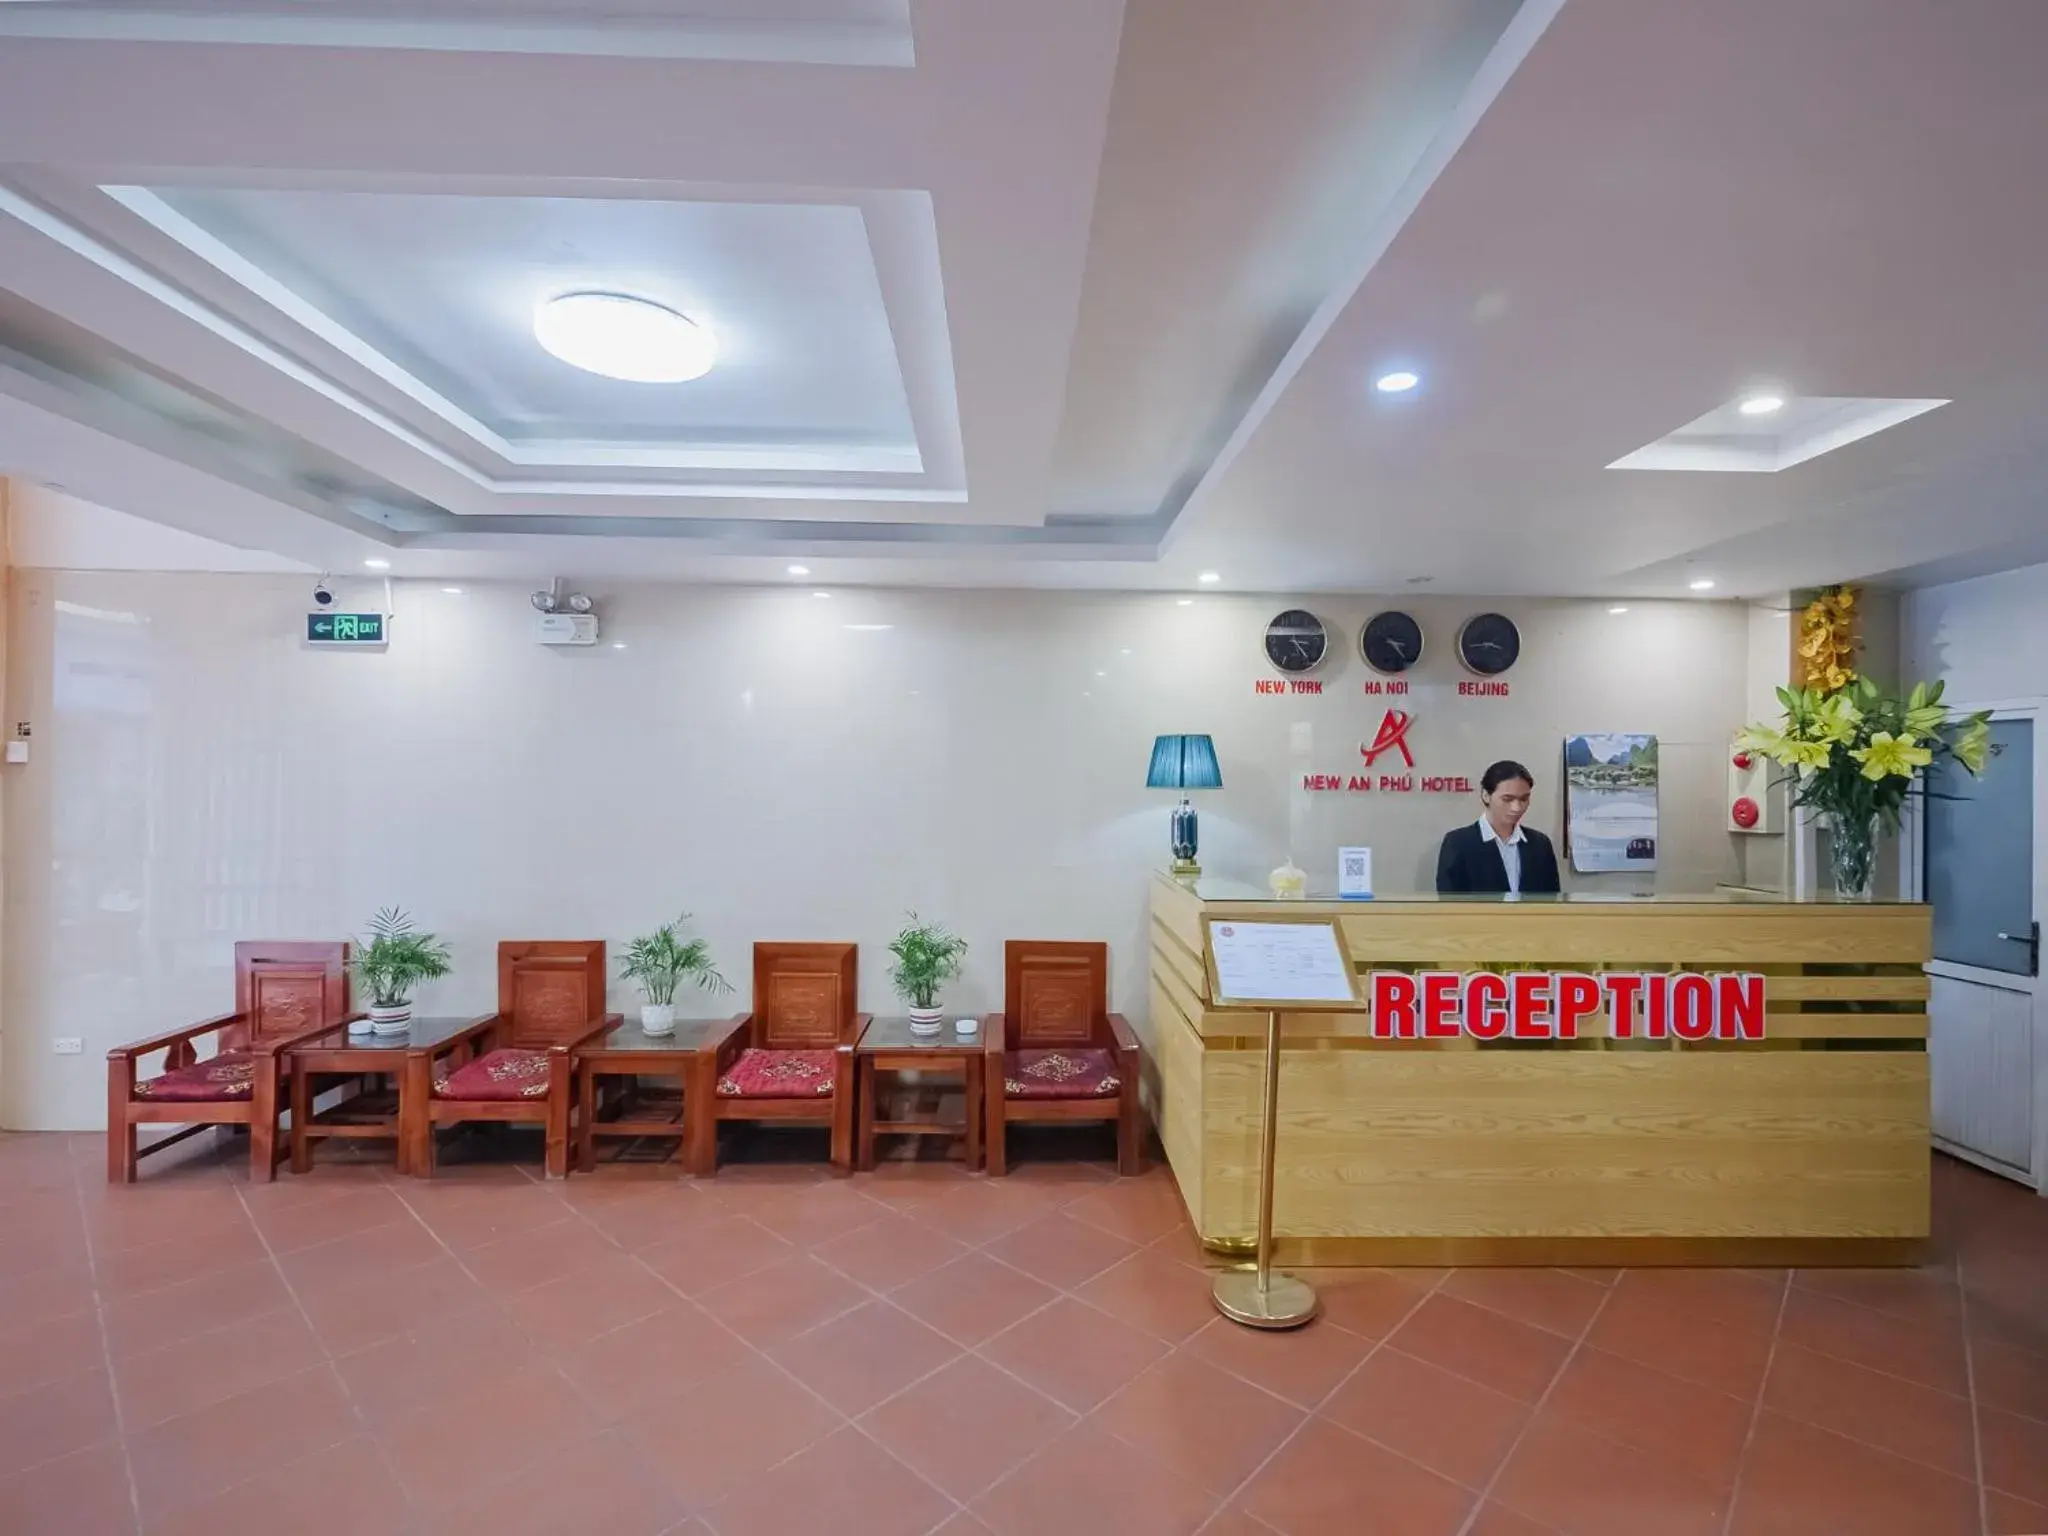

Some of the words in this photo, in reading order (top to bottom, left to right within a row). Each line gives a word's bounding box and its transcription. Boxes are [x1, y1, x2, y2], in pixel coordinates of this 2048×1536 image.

[360, 622, 378, 633] EXIT
[1256, 680, 1285, 694] NEW
[1291, 680, 1323, 694] YORK
[1365, 681, 1382, 695] HA
[1386, 681, 1409, 695] NOI
[1458, 682, 1509, 697] BEIJING
[1303, 774, 1341, 791] NEW
[1348, 776, 1371, 791] AN
[1421, 777, 1473, 792] HOTEL
[1371, 972, 1766, 1040] RECEPTION
